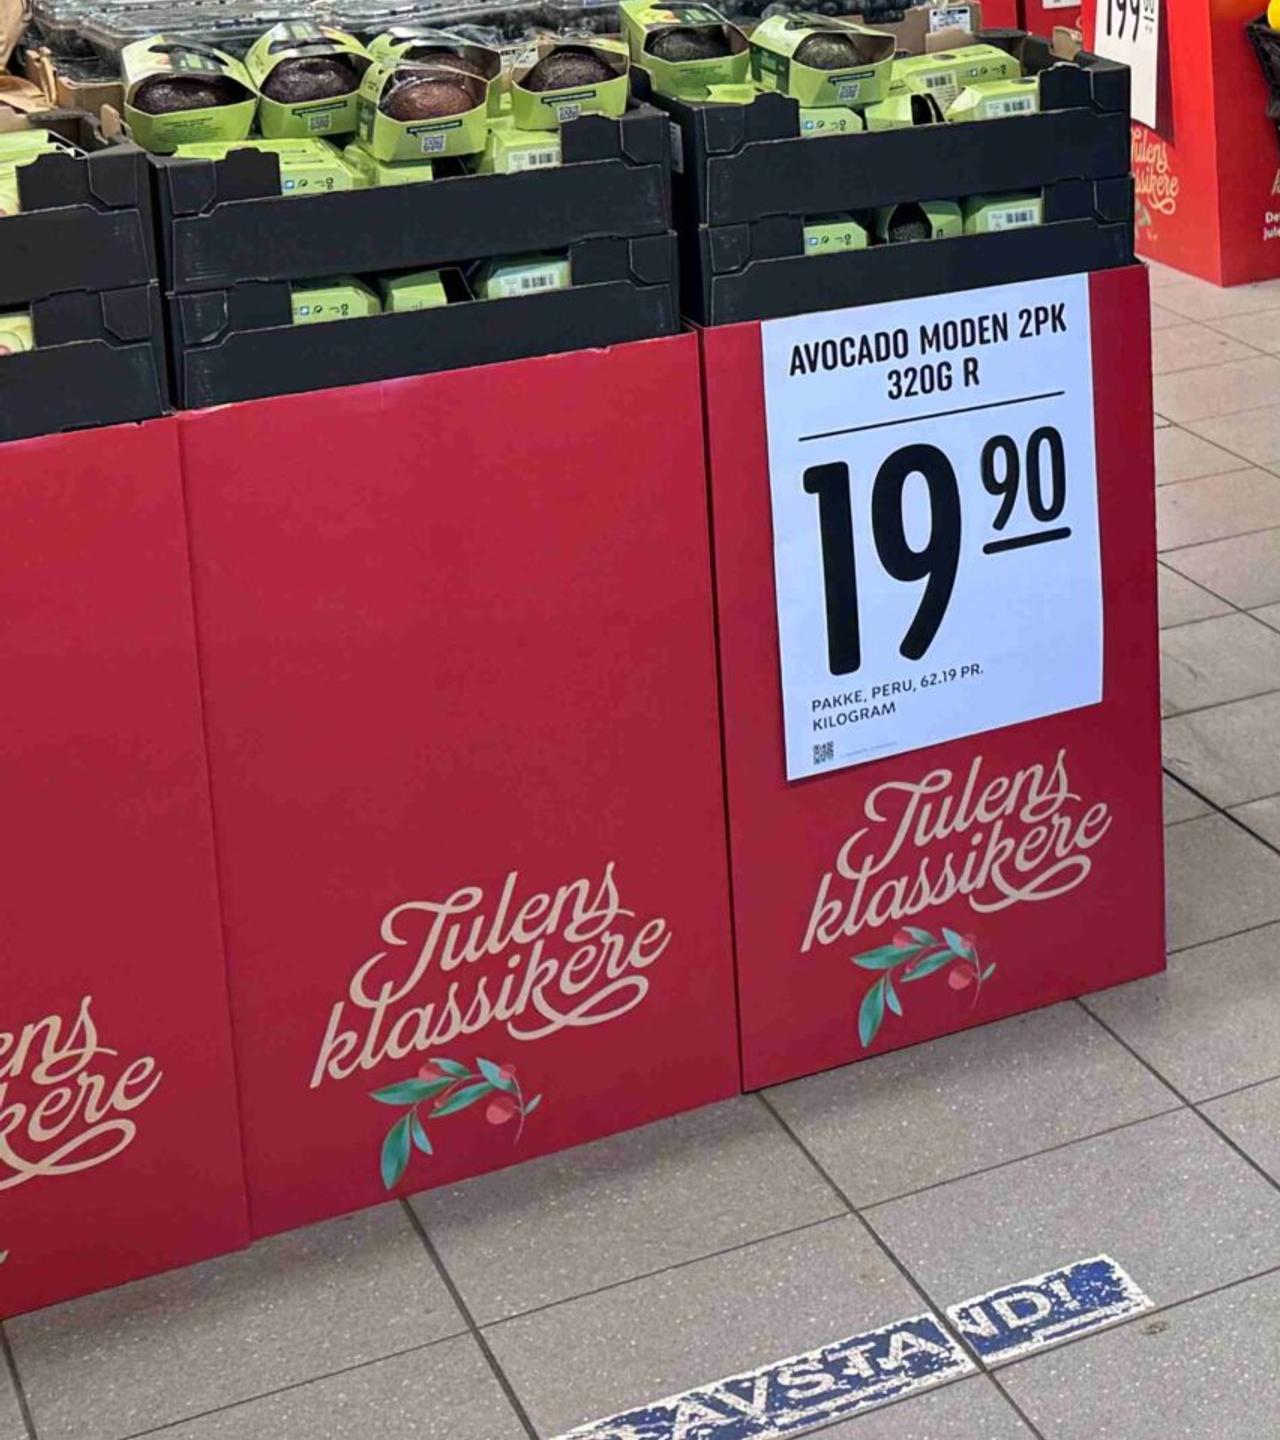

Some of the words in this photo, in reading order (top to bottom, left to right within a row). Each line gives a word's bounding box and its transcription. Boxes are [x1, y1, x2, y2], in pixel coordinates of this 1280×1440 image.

[789, 328, 909, 377] AVOCADO
[919, 315, 1010, 353] MODEN
[1018, 303, 1067, 339] 2PK
[887, 360, 953, 401] 320G
[963, 357, 980, 387] R
[802, 443, 963, 677] 19
[980, 425, 1067, 531] 90
[811, 691, 867, 713] PAKKE,
[872, 678, 918, 701] PERU,
[920, 669, 958, 689] 62.19
[960, 663, 985, 681] PR.
[811, 702, 897, 733] KILOGRAM
[836, 749, 1082, 881] Julens
[801, 803, 1113, 953] klassikere
[350, 861, 635, 1008] Julens
[0, 995, 118, 1085] ens
[310, 918, 672, 1089] klassikere
